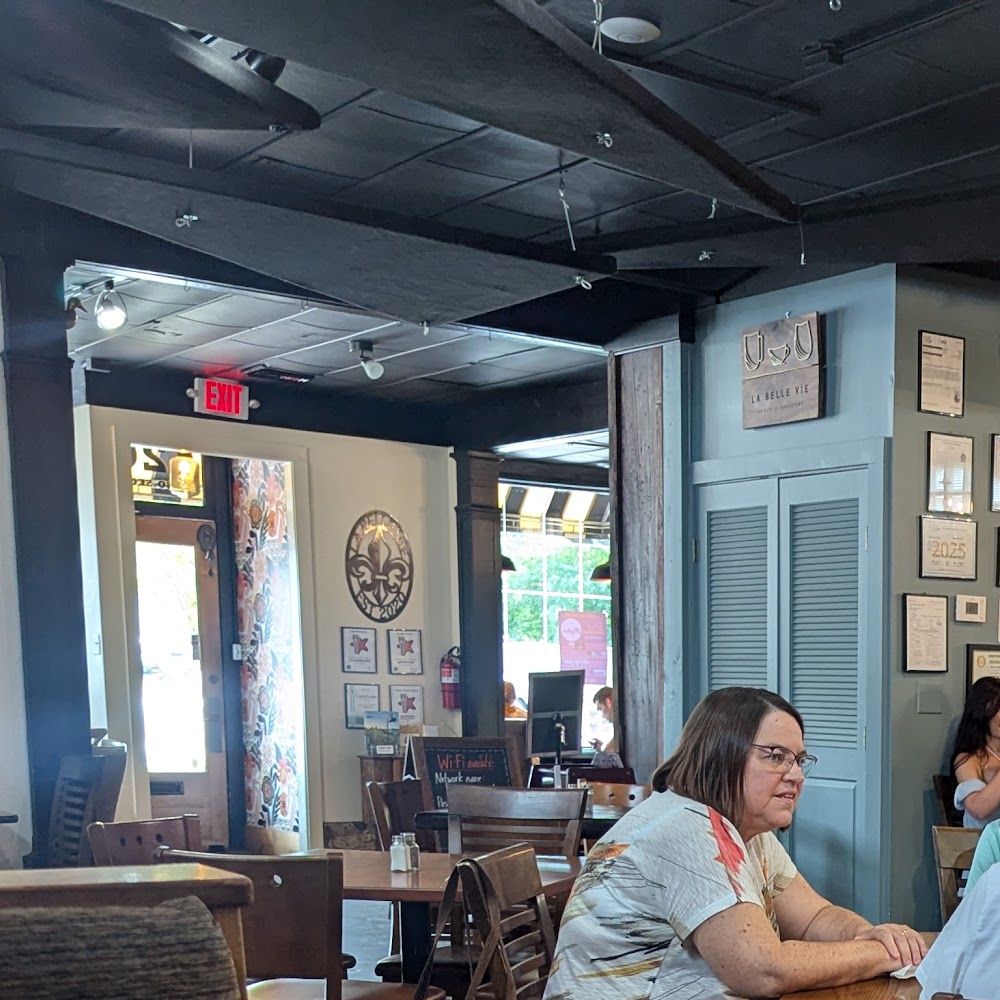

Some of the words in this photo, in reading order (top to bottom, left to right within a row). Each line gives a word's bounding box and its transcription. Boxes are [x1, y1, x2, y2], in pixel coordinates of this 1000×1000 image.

[206, 380, 243, 415] EXIT
[751, 394, 761, 404] LA
[765, 388, 790, 401] BELLE
[795, 384, 809, 395] VIE
[931, 540, 966, 560] 2025
[380, 591, 406, 620] 2020
[435, 771, 463, 784] Network
[436, 795, 448, 808] Pas
